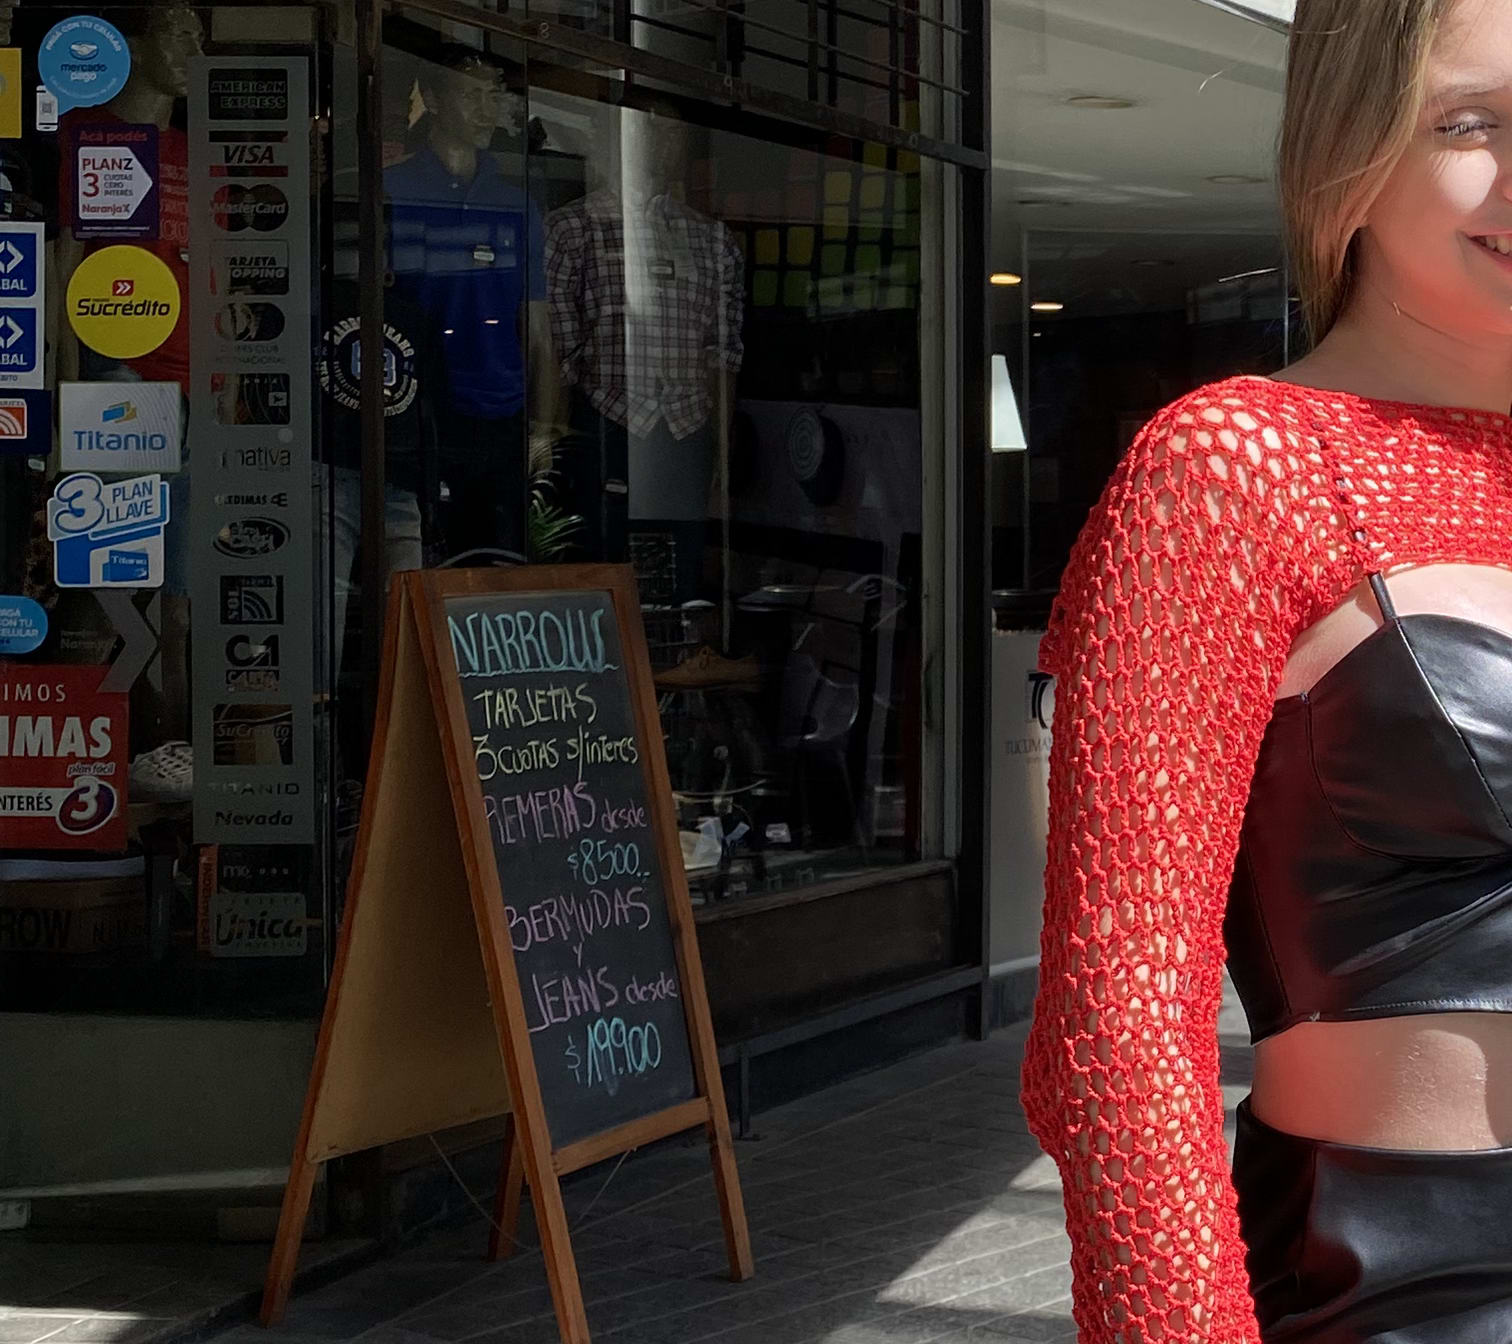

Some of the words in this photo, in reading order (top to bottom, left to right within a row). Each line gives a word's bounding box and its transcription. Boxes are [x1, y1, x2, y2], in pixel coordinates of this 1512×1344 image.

[61, 63, 107, 72] mercado
[70, 72, 97, 83] pago
[209, 81, 286, 93] AMERICAN
[220, 96, 287, 109] EXPRESS
[224, 145, 274, 164] VISA
[82, 173, 99, 197] 3
[224, 256, 276, 266] ARJETA
[231, 269, 286, 279] OPPING
[0, 279, 27, 291] BAL
[77, 298, 170, 316] Sucrédito
[0, 353, 28, 366] BAL
[74, 430, 166, 450] Titanio
[112, 481, 153, 503] PLAN
[56, 475, 104, 533] 3
[107, 498, 153, 524] LLAVE
[473, 682, 598, 729] TARJETAS
[473, 733, 497, 781] 3
[500, 737, 560, 774] CUOTAS
[70, 775, 101, 821] 3
[215, 810, 293, 826] Nevada
[484, 782, 596, 845] REMERAS
[602, 798, 648, 834] desde
[504, 886, 651, 952] BERMUDAS
[530, 965, 619, 1033] JEANS
[626, 972, 679, 1005] desde
